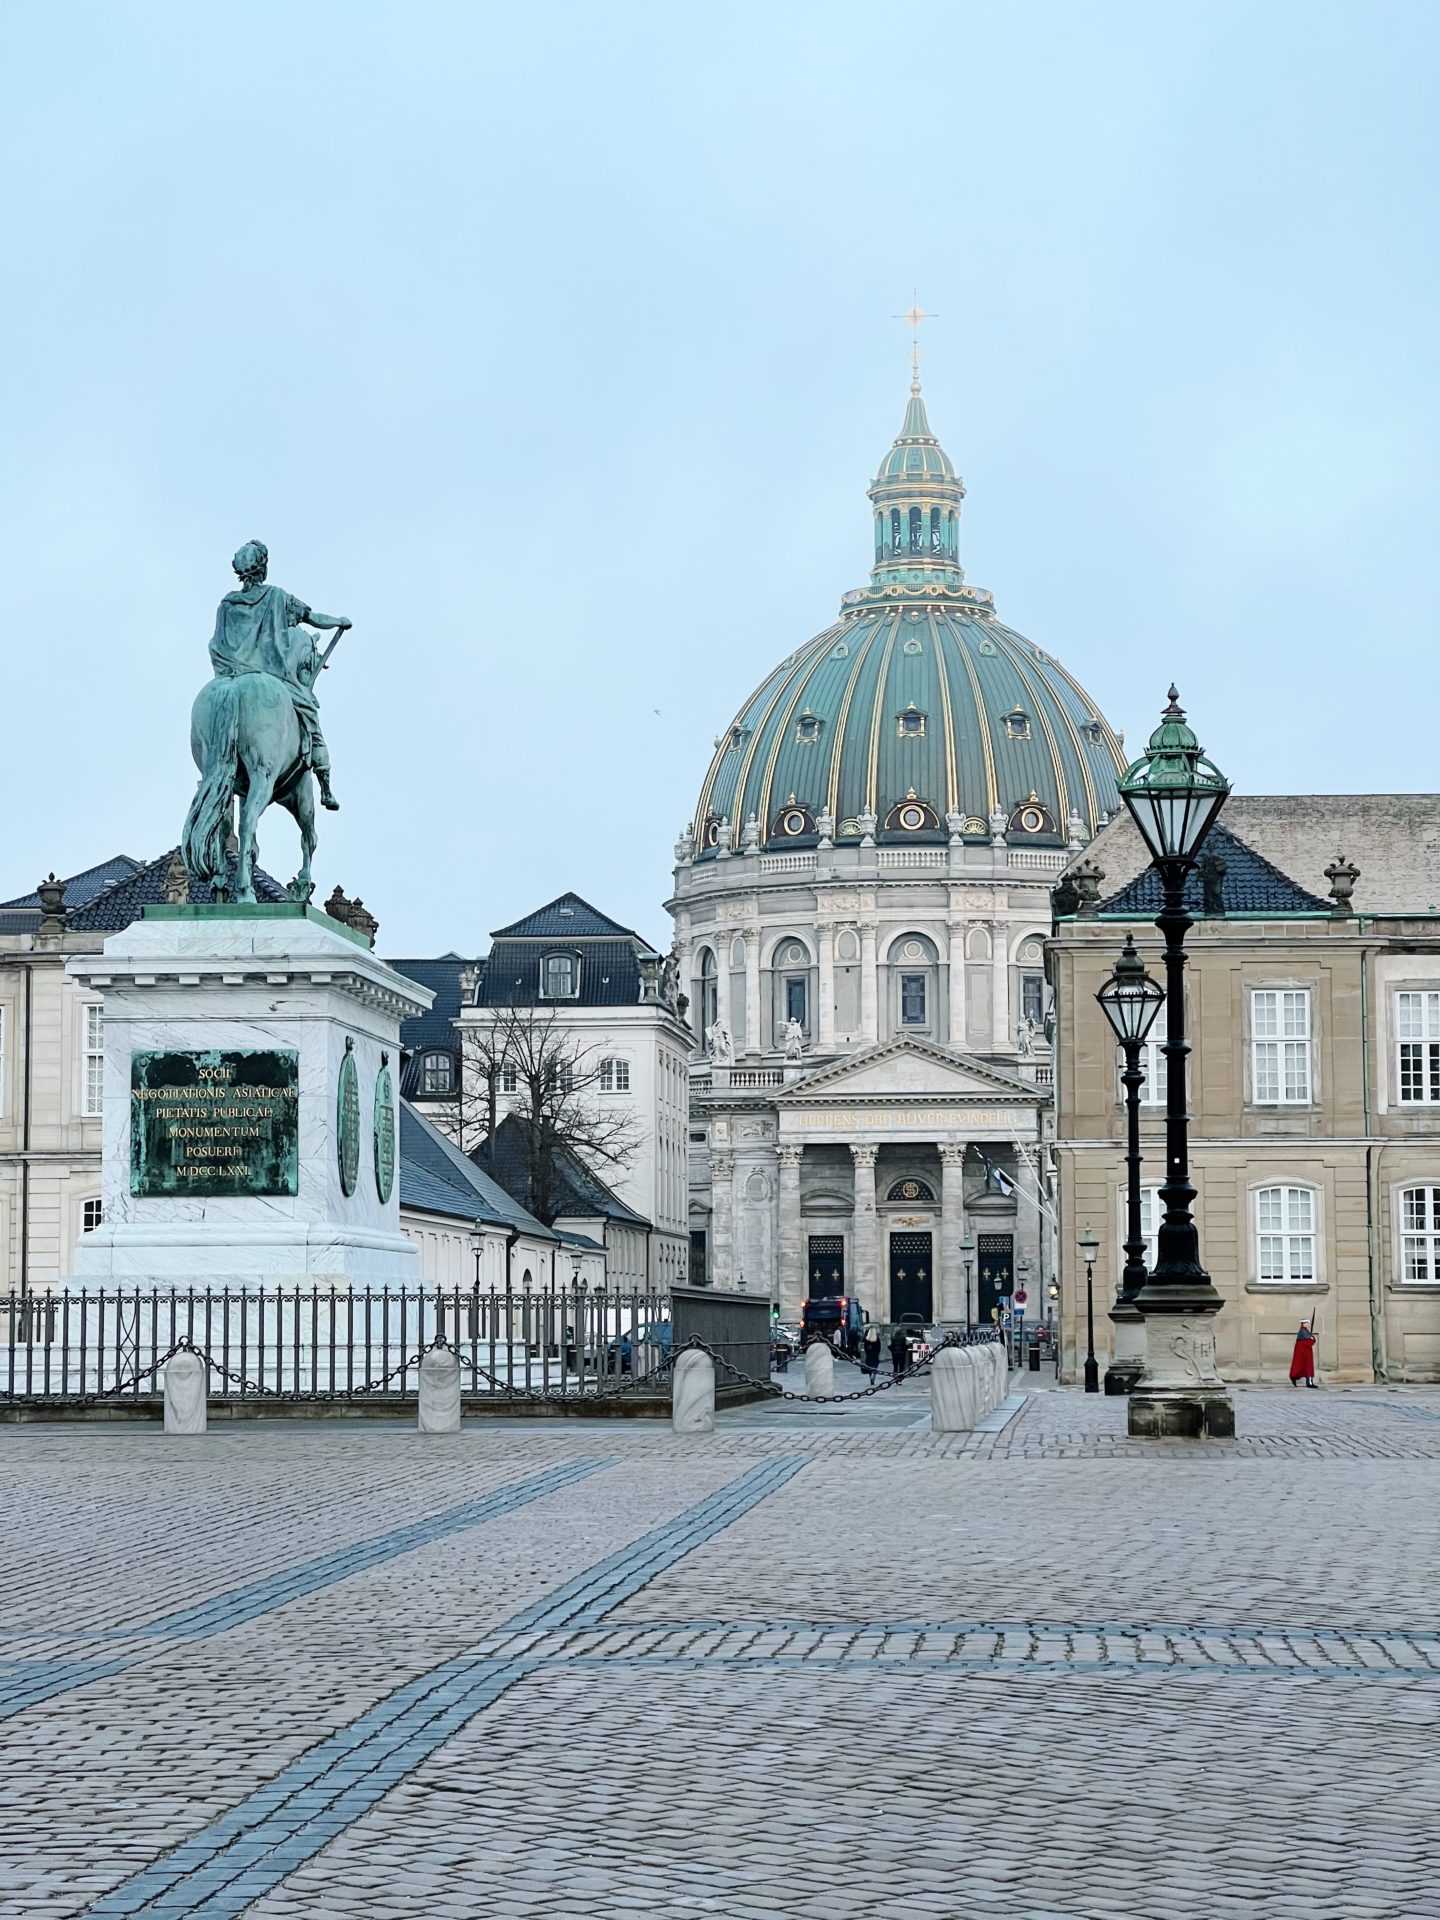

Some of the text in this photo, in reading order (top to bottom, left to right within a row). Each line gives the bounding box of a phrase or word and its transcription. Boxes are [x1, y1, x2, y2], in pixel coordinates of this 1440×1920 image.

[132, 1088, 295, 1099] NEGOTIATIONIS ASIATICAE
[156, 1107, 207, 1118] PIETATIS
[169, 1127, 259, 1138] MONUMENTUM
